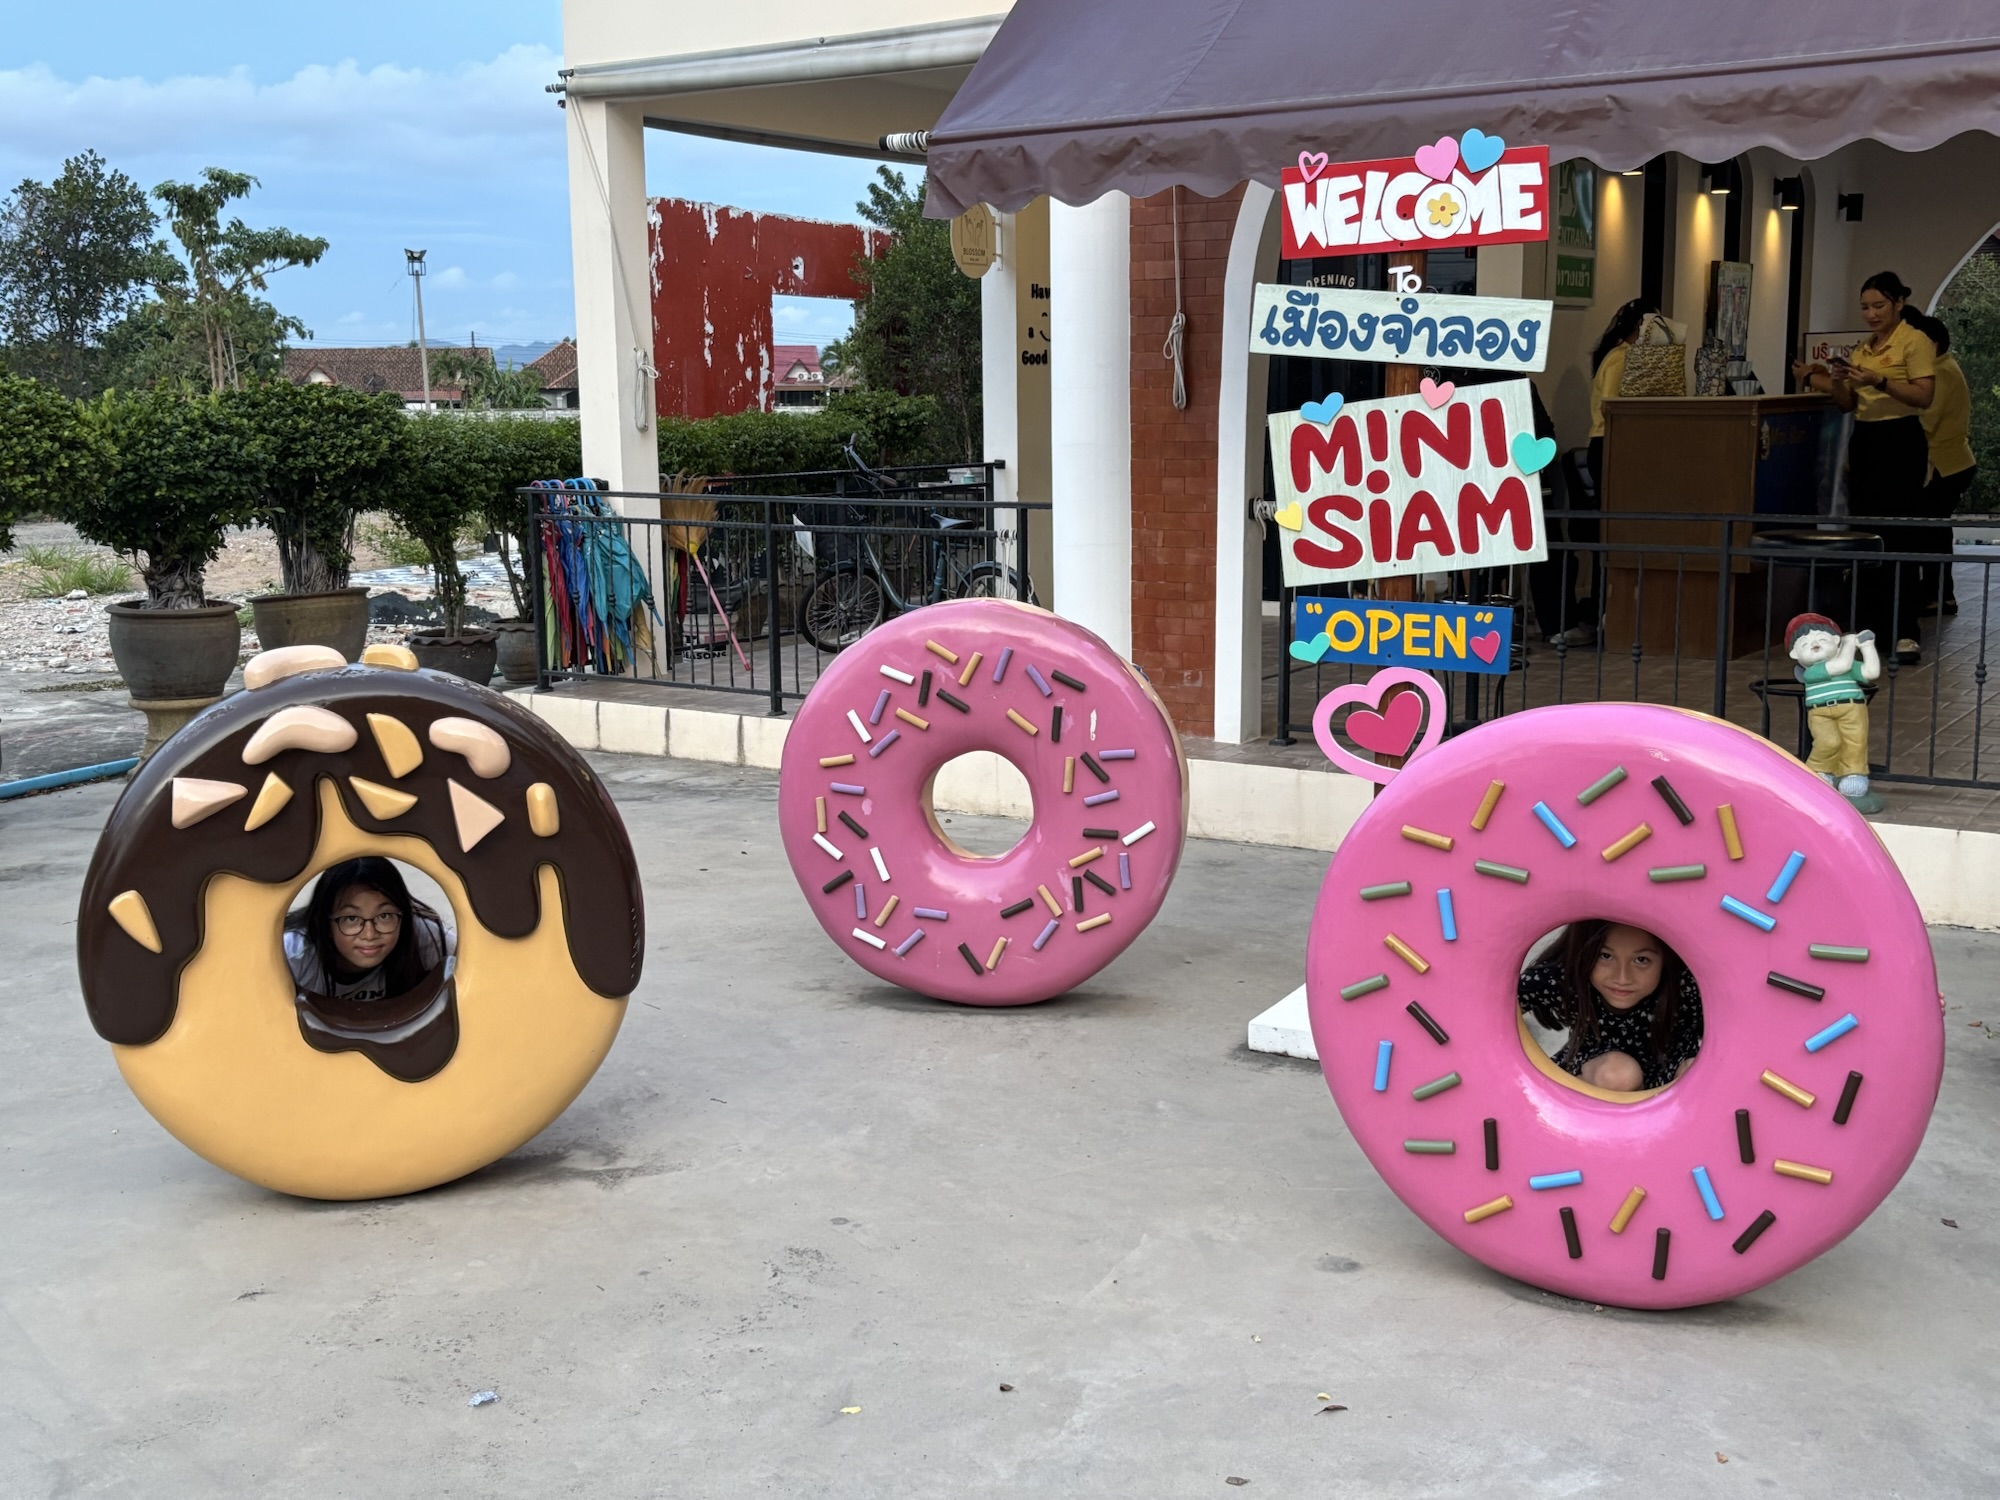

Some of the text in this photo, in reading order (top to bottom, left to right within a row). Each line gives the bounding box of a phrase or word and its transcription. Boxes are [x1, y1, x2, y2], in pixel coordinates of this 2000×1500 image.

[1284, 162, 1543, 249] WELCOME
[1306, 274, 1355, 288] OPENING
[1031, 283, 1051, 299] Hav
[1260, 290, 1541, 362] เมืองจำลอง
[1022, 350, 1048, 365] Good
